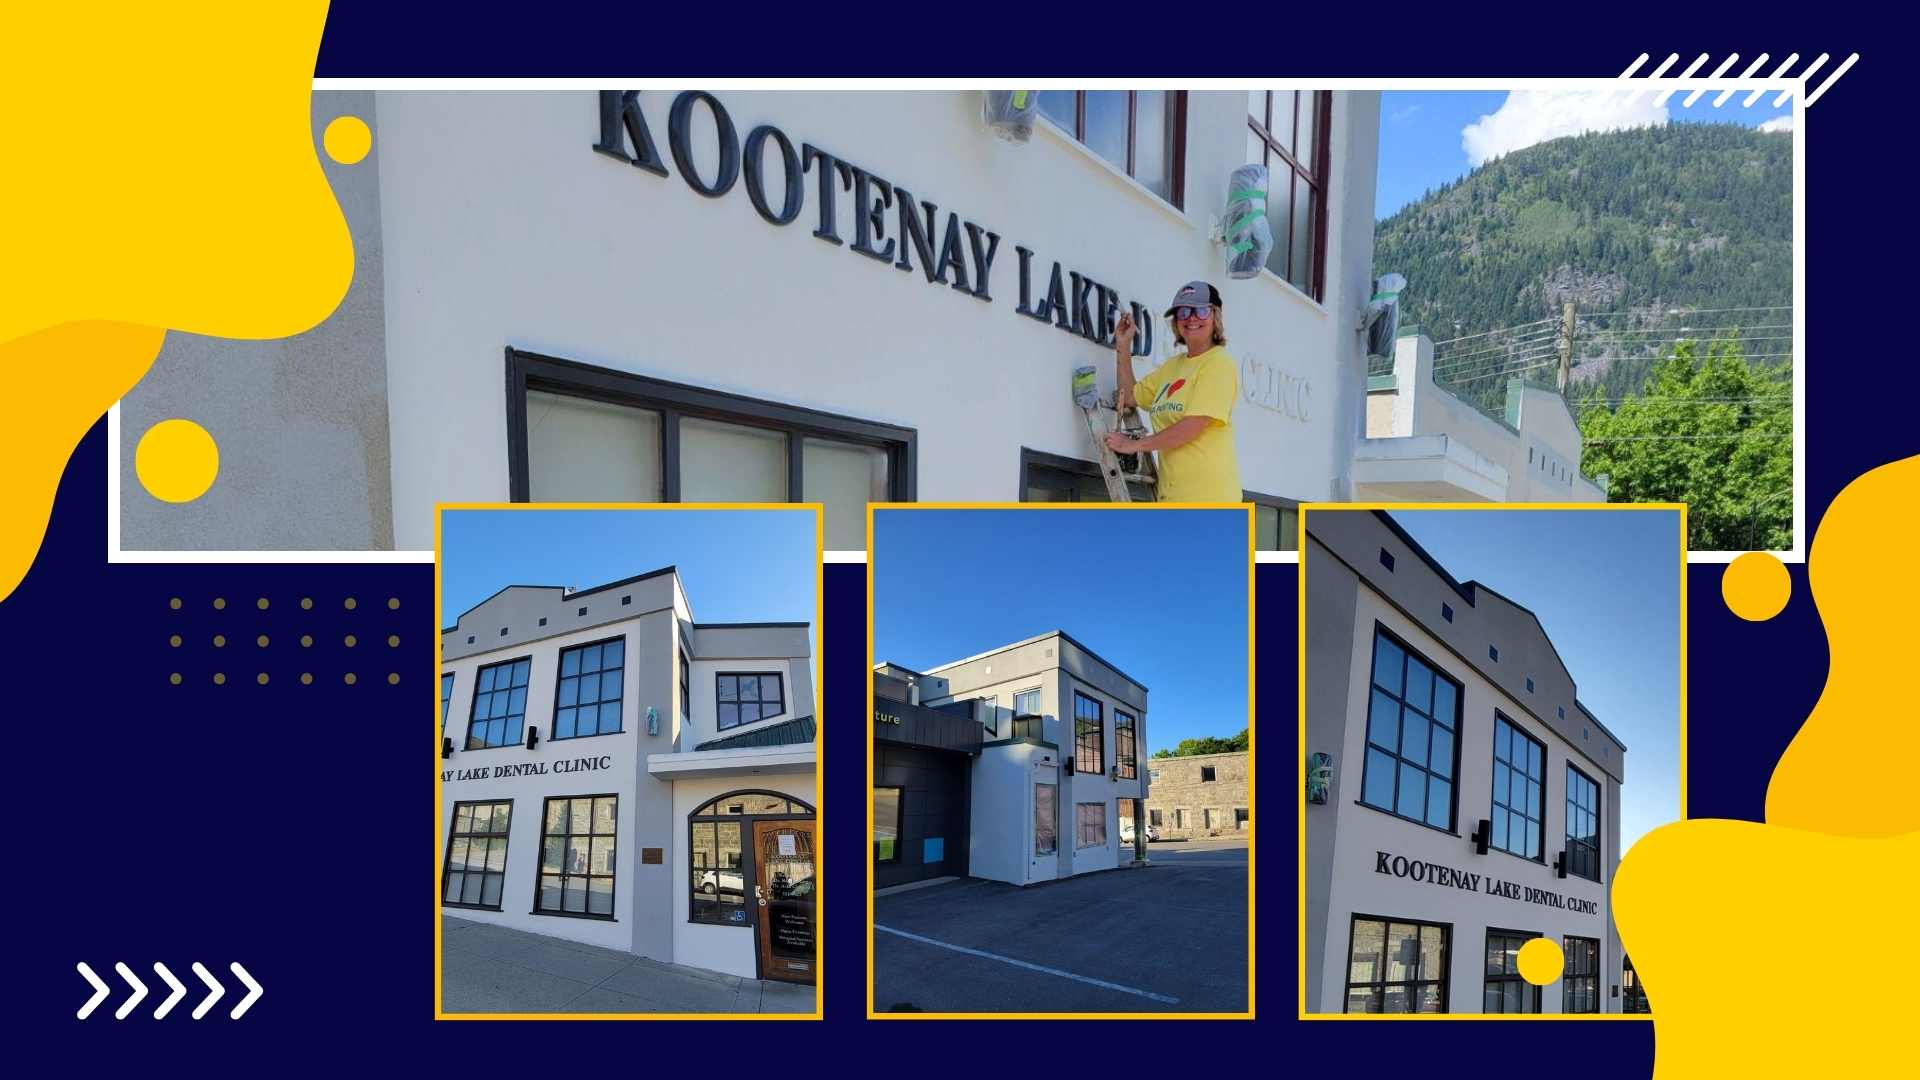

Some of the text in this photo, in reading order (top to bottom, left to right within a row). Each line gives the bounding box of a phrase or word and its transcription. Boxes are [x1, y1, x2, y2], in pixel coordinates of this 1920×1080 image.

[593, 90, 1000, 302] KOOTENAY
[1015, 246, 1120, 350] LAKE
[875, 711, 900, 725] ture
[456, 767, 490, 781] LAKE
[494, 762, 548, 778] DENTAL
[553, 756, 611, 774] CLINIC
[1375, 851, 1598, 916] KOOTENAY LAKE DENTAL CLINIC
